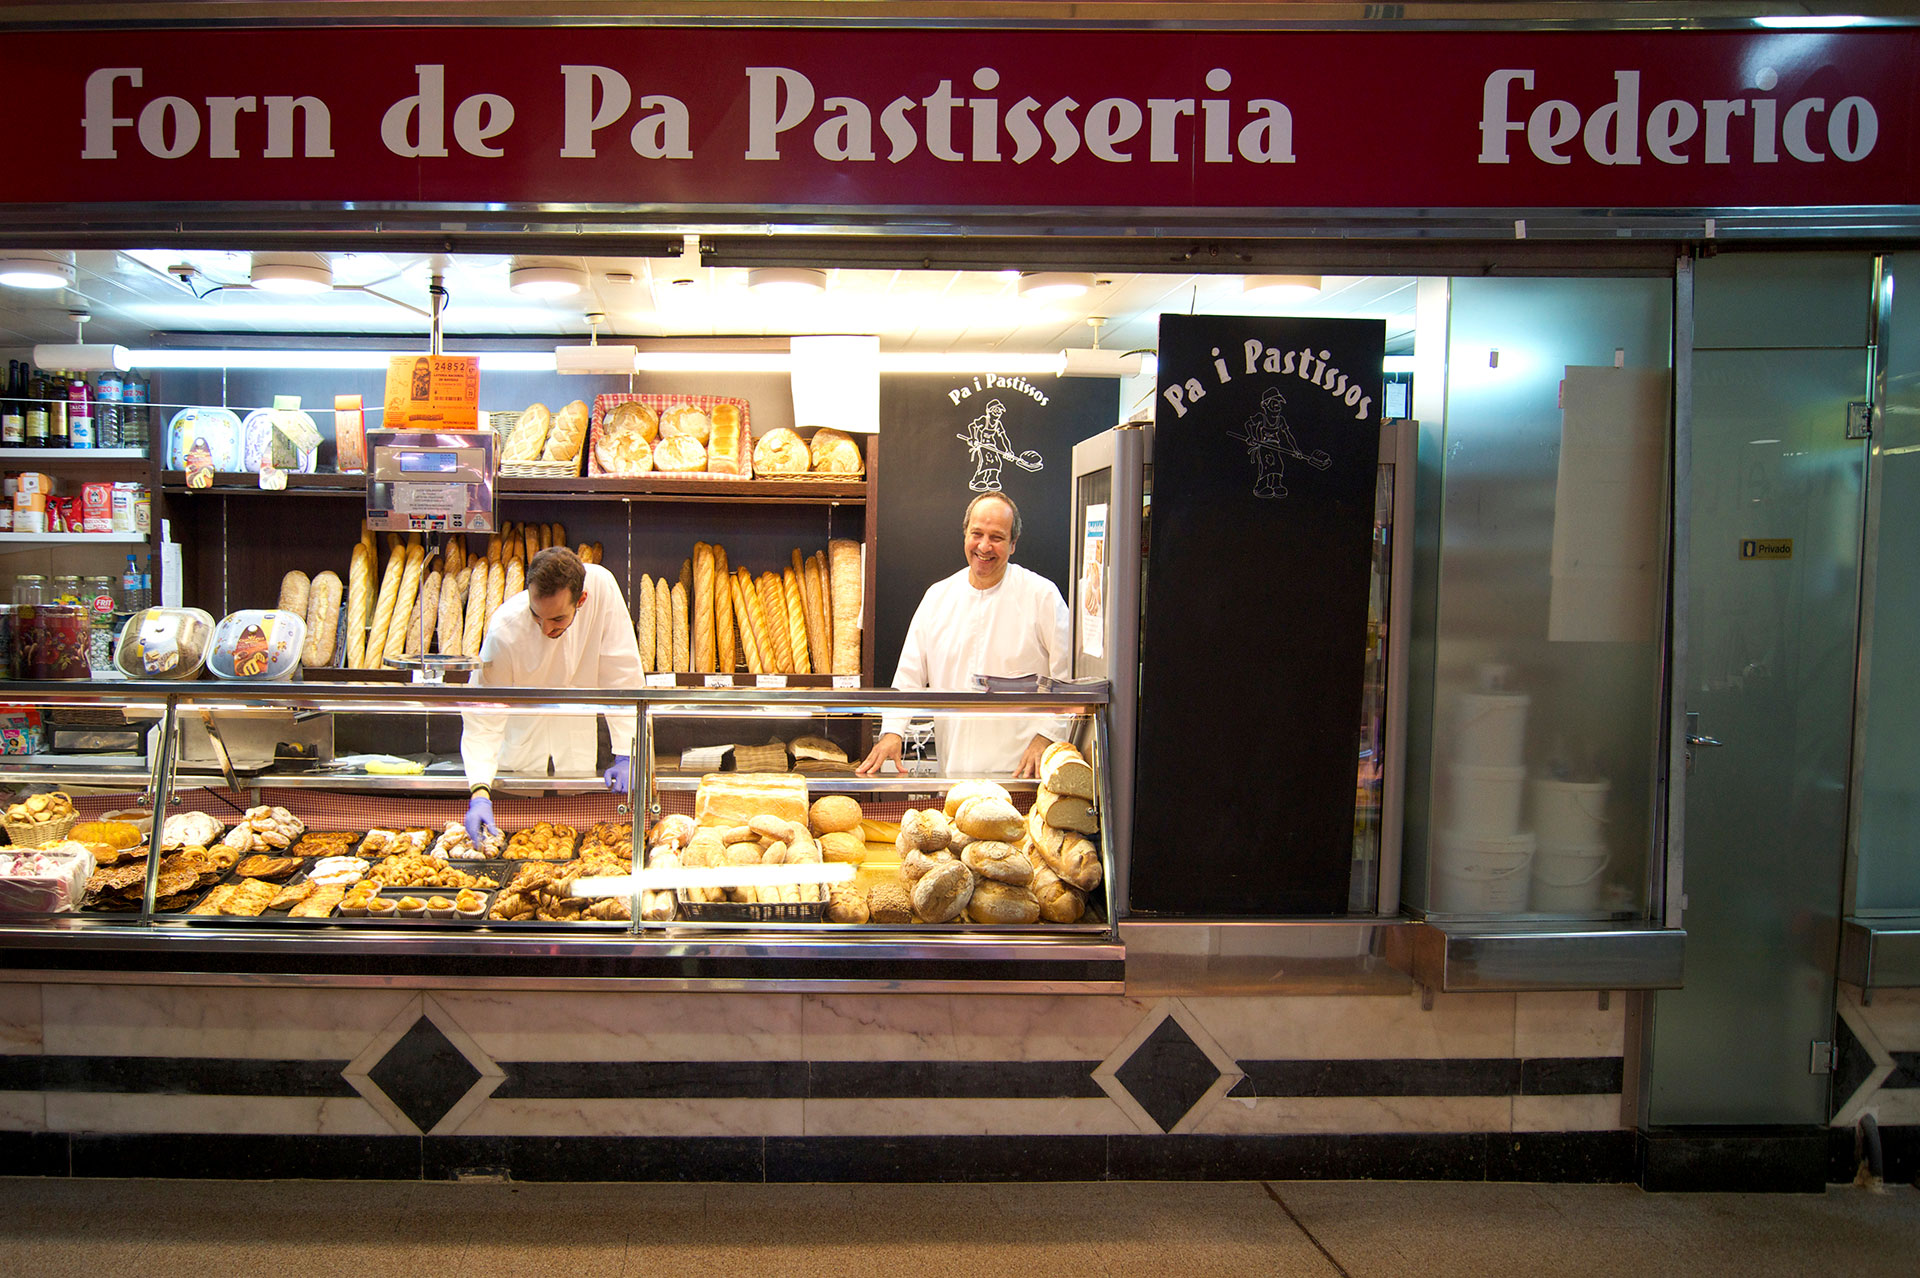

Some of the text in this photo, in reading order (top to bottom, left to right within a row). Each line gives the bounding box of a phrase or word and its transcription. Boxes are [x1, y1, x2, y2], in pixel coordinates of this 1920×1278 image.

[380, 64, 515, 158] de
[559, 64, 694, 159] Pa
[744, 66, 1296, 164] Pastisseria
[434, 362, 465, 371] 24852
[1163, 376, 1207, 419] Pa
[1211, 346, 1232, 384] i
[1243, 338, 1373, 420] Pastissos
[947, 372, 1050, 407] Pa i Pastissos
[1758, 544, 1791, 553] Privado
